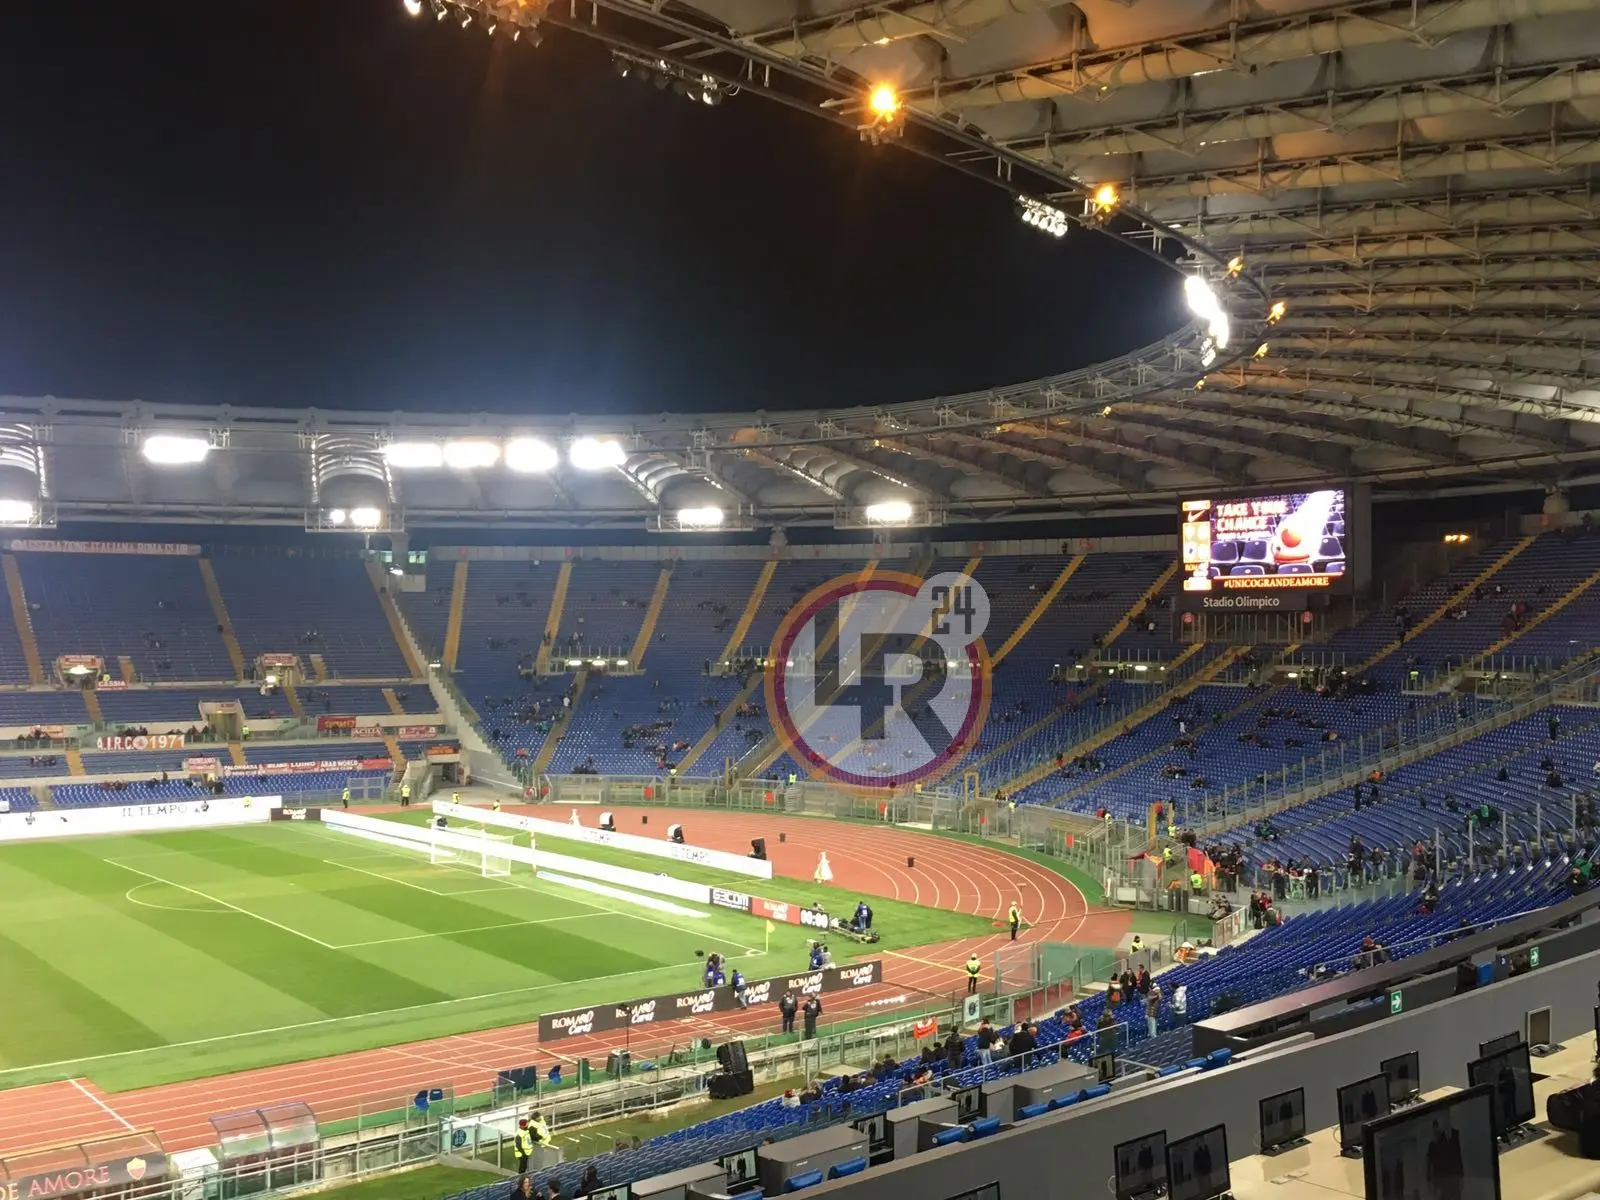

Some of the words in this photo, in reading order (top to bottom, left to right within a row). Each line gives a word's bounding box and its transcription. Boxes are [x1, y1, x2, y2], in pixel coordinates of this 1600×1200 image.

[1223, 577, 1330, 588] #UNICOGRANDEAMORE
[1203, 596, 1233, 608] Stadio
[1235, 596, 1280, 609] Olimpico
[150, 734, 185, 749] 1971
[139, 804, 188, 816] TEMPO
[27, 1165, 110, 1199] AMORE
